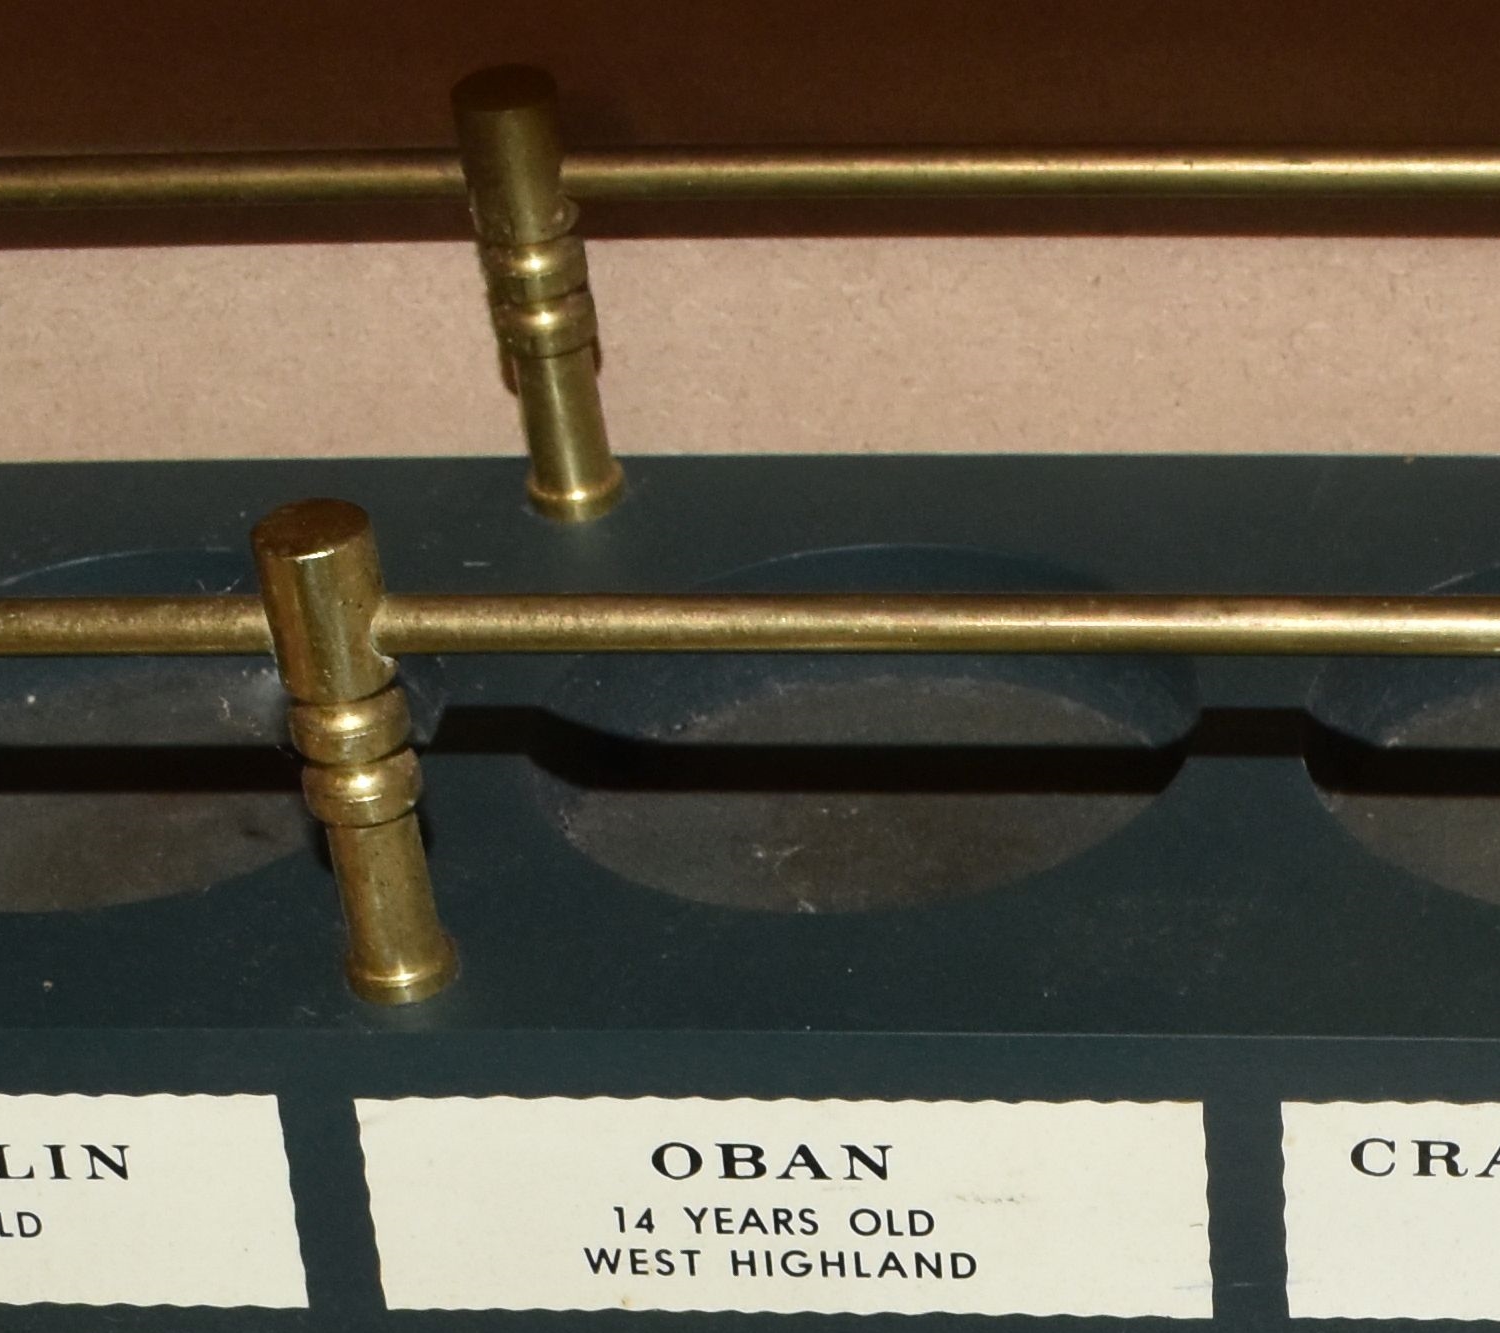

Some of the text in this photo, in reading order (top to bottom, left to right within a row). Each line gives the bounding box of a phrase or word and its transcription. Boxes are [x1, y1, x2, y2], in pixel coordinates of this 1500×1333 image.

[651, 1142, 893, 1181] OBAN
[613, 1206, 935, 1237] 14 YEARS OLD
[583, 1247, 977, 1279] WEST HIGHLAND
